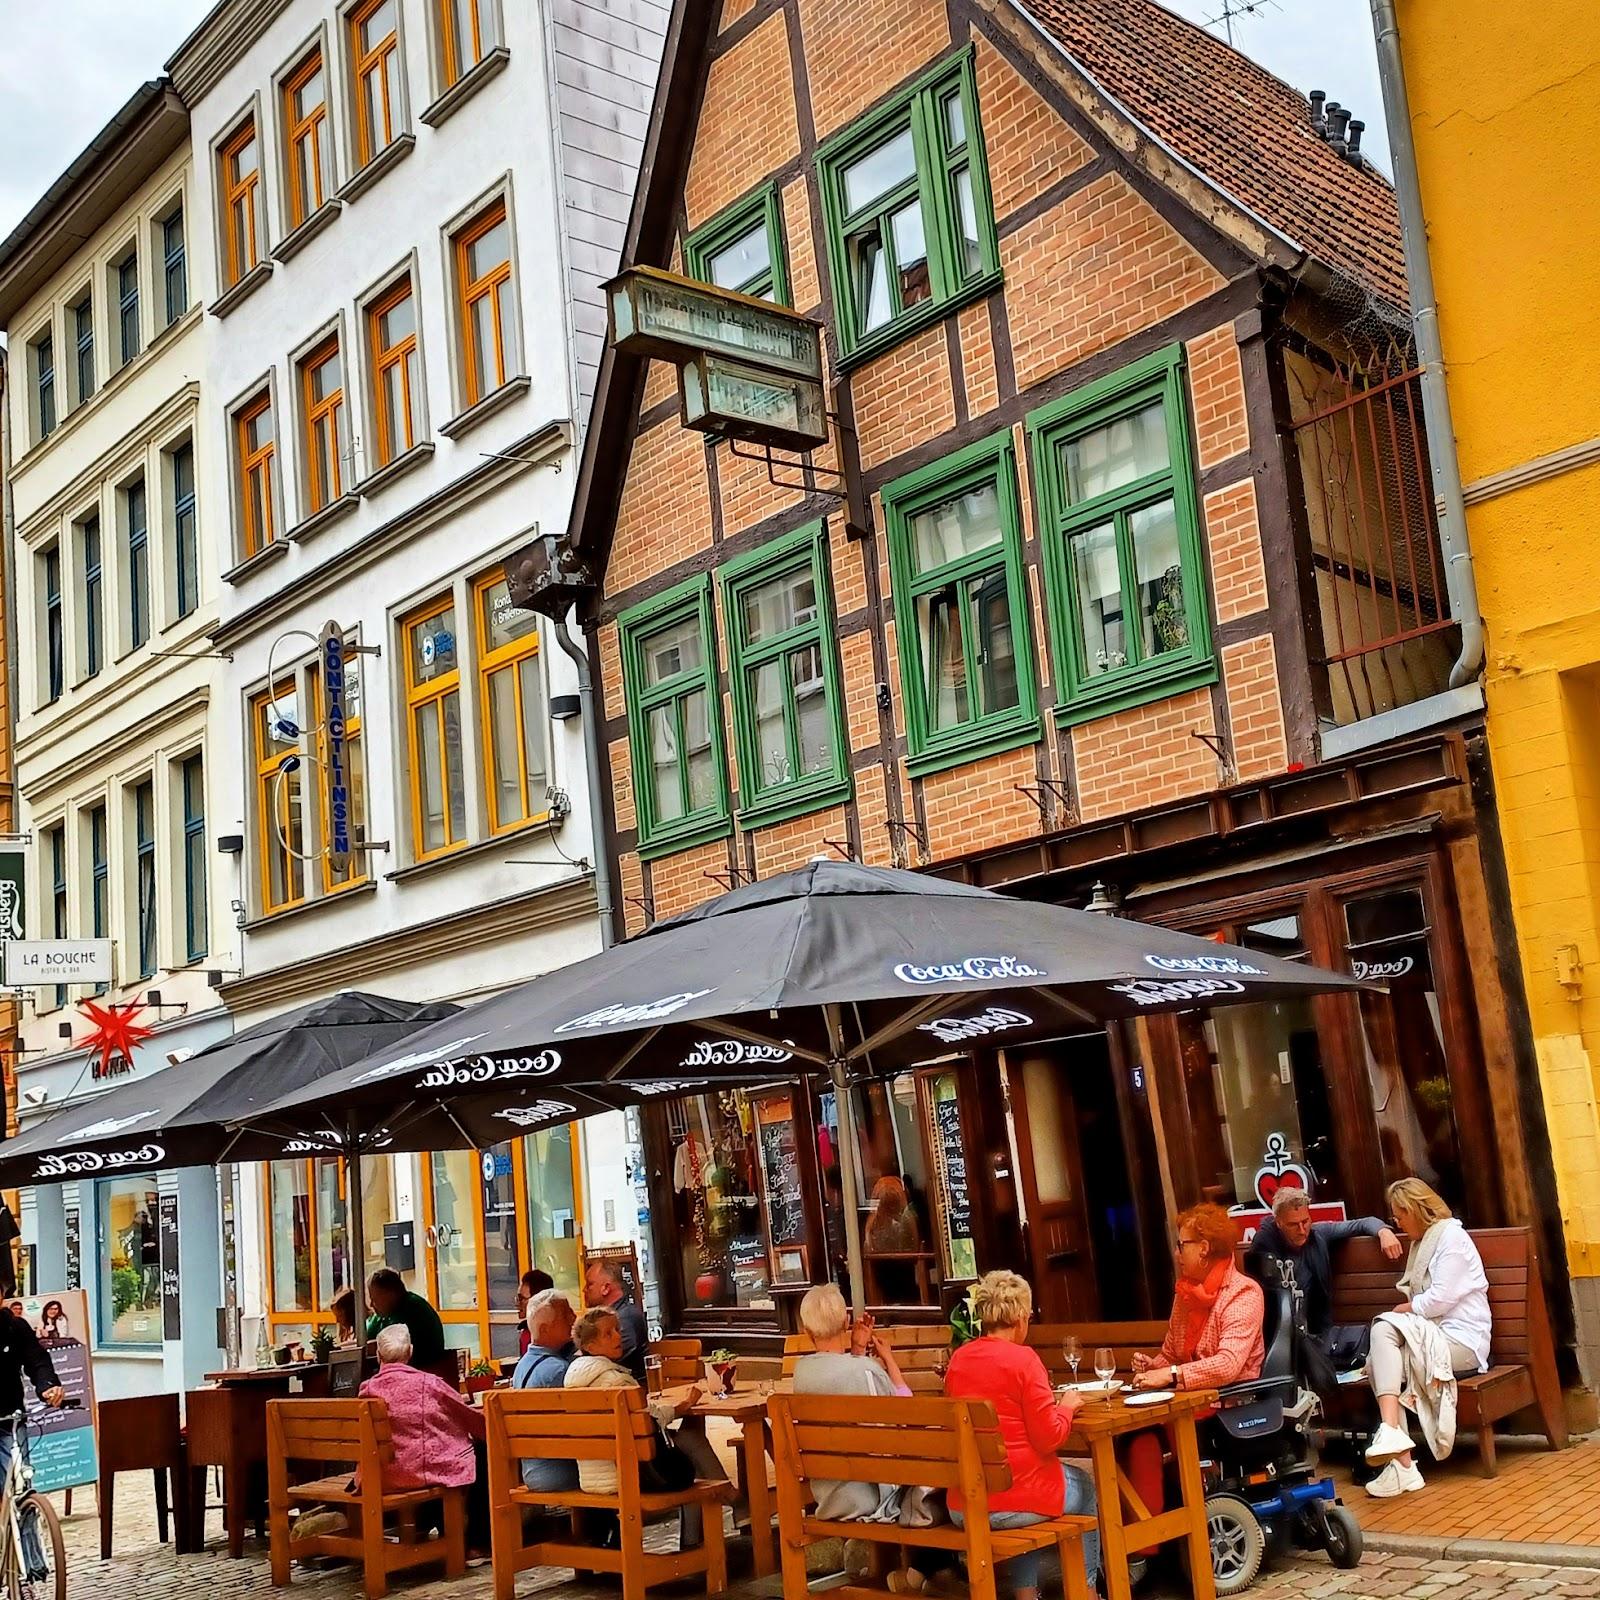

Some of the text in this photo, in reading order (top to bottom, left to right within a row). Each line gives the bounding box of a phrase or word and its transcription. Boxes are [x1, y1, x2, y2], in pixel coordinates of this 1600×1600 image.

[326, 637, 349, 853] CONTACTLINSEN
[23, 952, 96, 966] LA BOUCHE
[1145, 954, 1268, 975] Coca-Cola
[894, 955, 1047, 985] Coca-Cola
[1134, 1070, 1142, 1088] 5
